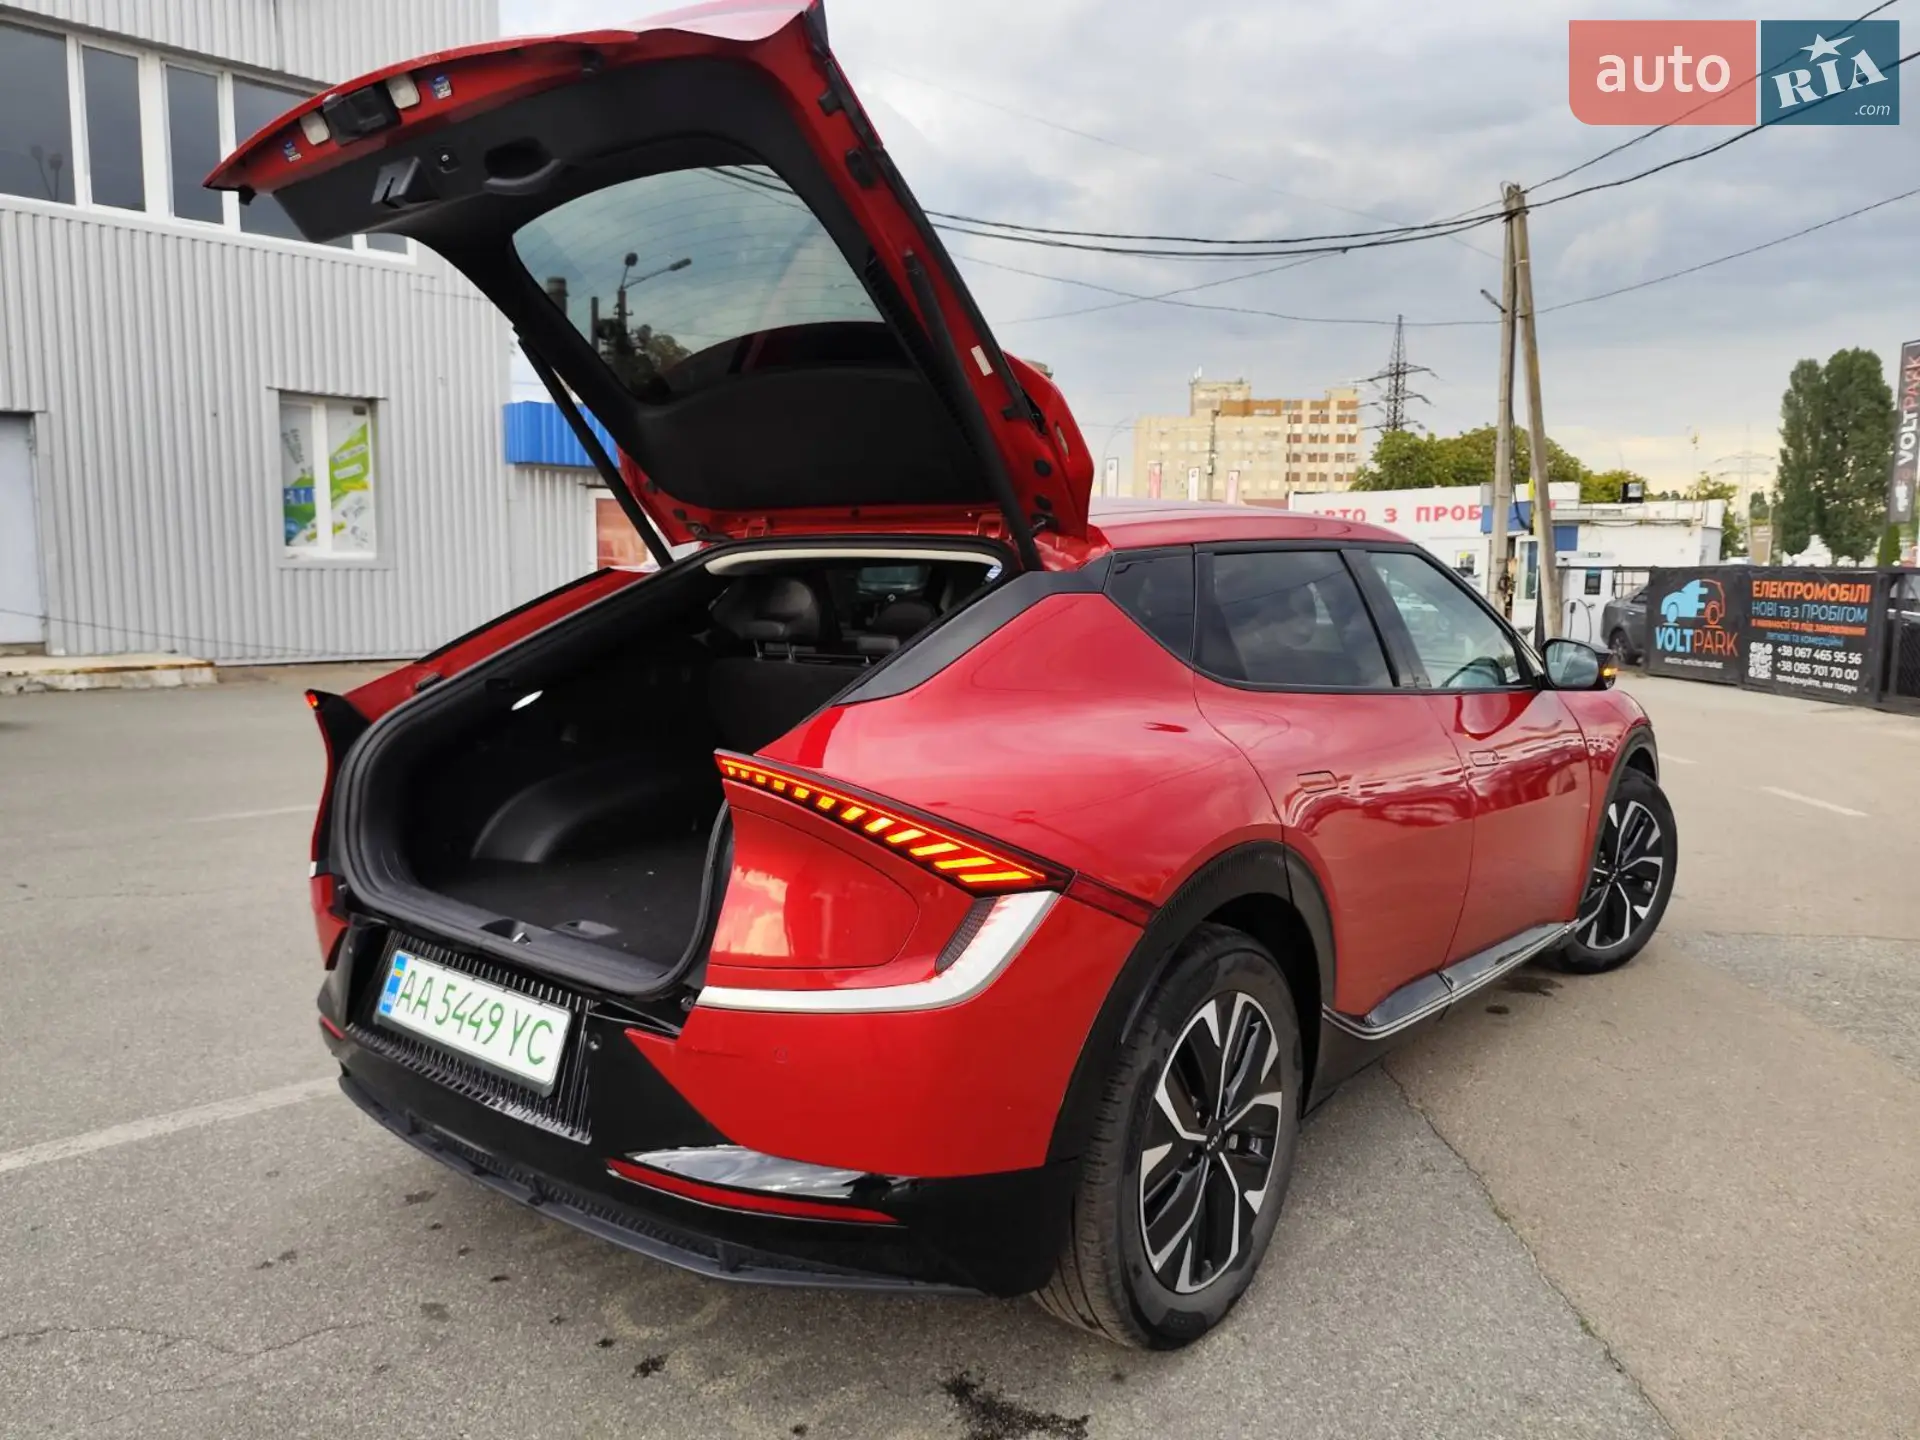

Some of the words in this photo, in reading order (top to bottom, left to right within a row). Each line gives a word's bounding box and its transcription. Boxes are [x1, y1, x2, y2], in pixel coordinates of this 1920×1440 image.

[1416, 504, 1483, 522] ПРОБ
[1752, 580, 1872, 603] ЕЛЕКТРОМОБІЛІ
[1752, 601, 1777, 617] НОВІ
[1801, 603, 1869, 623] ПРОБІГОМ
[1655, 626, 1738, 657] VOLTPARK
[1777, 645, 1793, 657] +38
[1794, 647, 1812, 658] 067
[1813, 649, 1832, 661] 465
[1833, 651, 1847, 663] 95
[1847, 652, 1863, 665] 56
[1777, 660, 1792, 672] +38
[1812, 664, 1829, 676] 701
[1830, 666, 1843, 679] 70
[1844, 669, 1859, 681] 00
[396, 970, 434, 1020] AA
[434, 983, 505, 1045] 5449
[509, 1008, 553, 1066] YC
